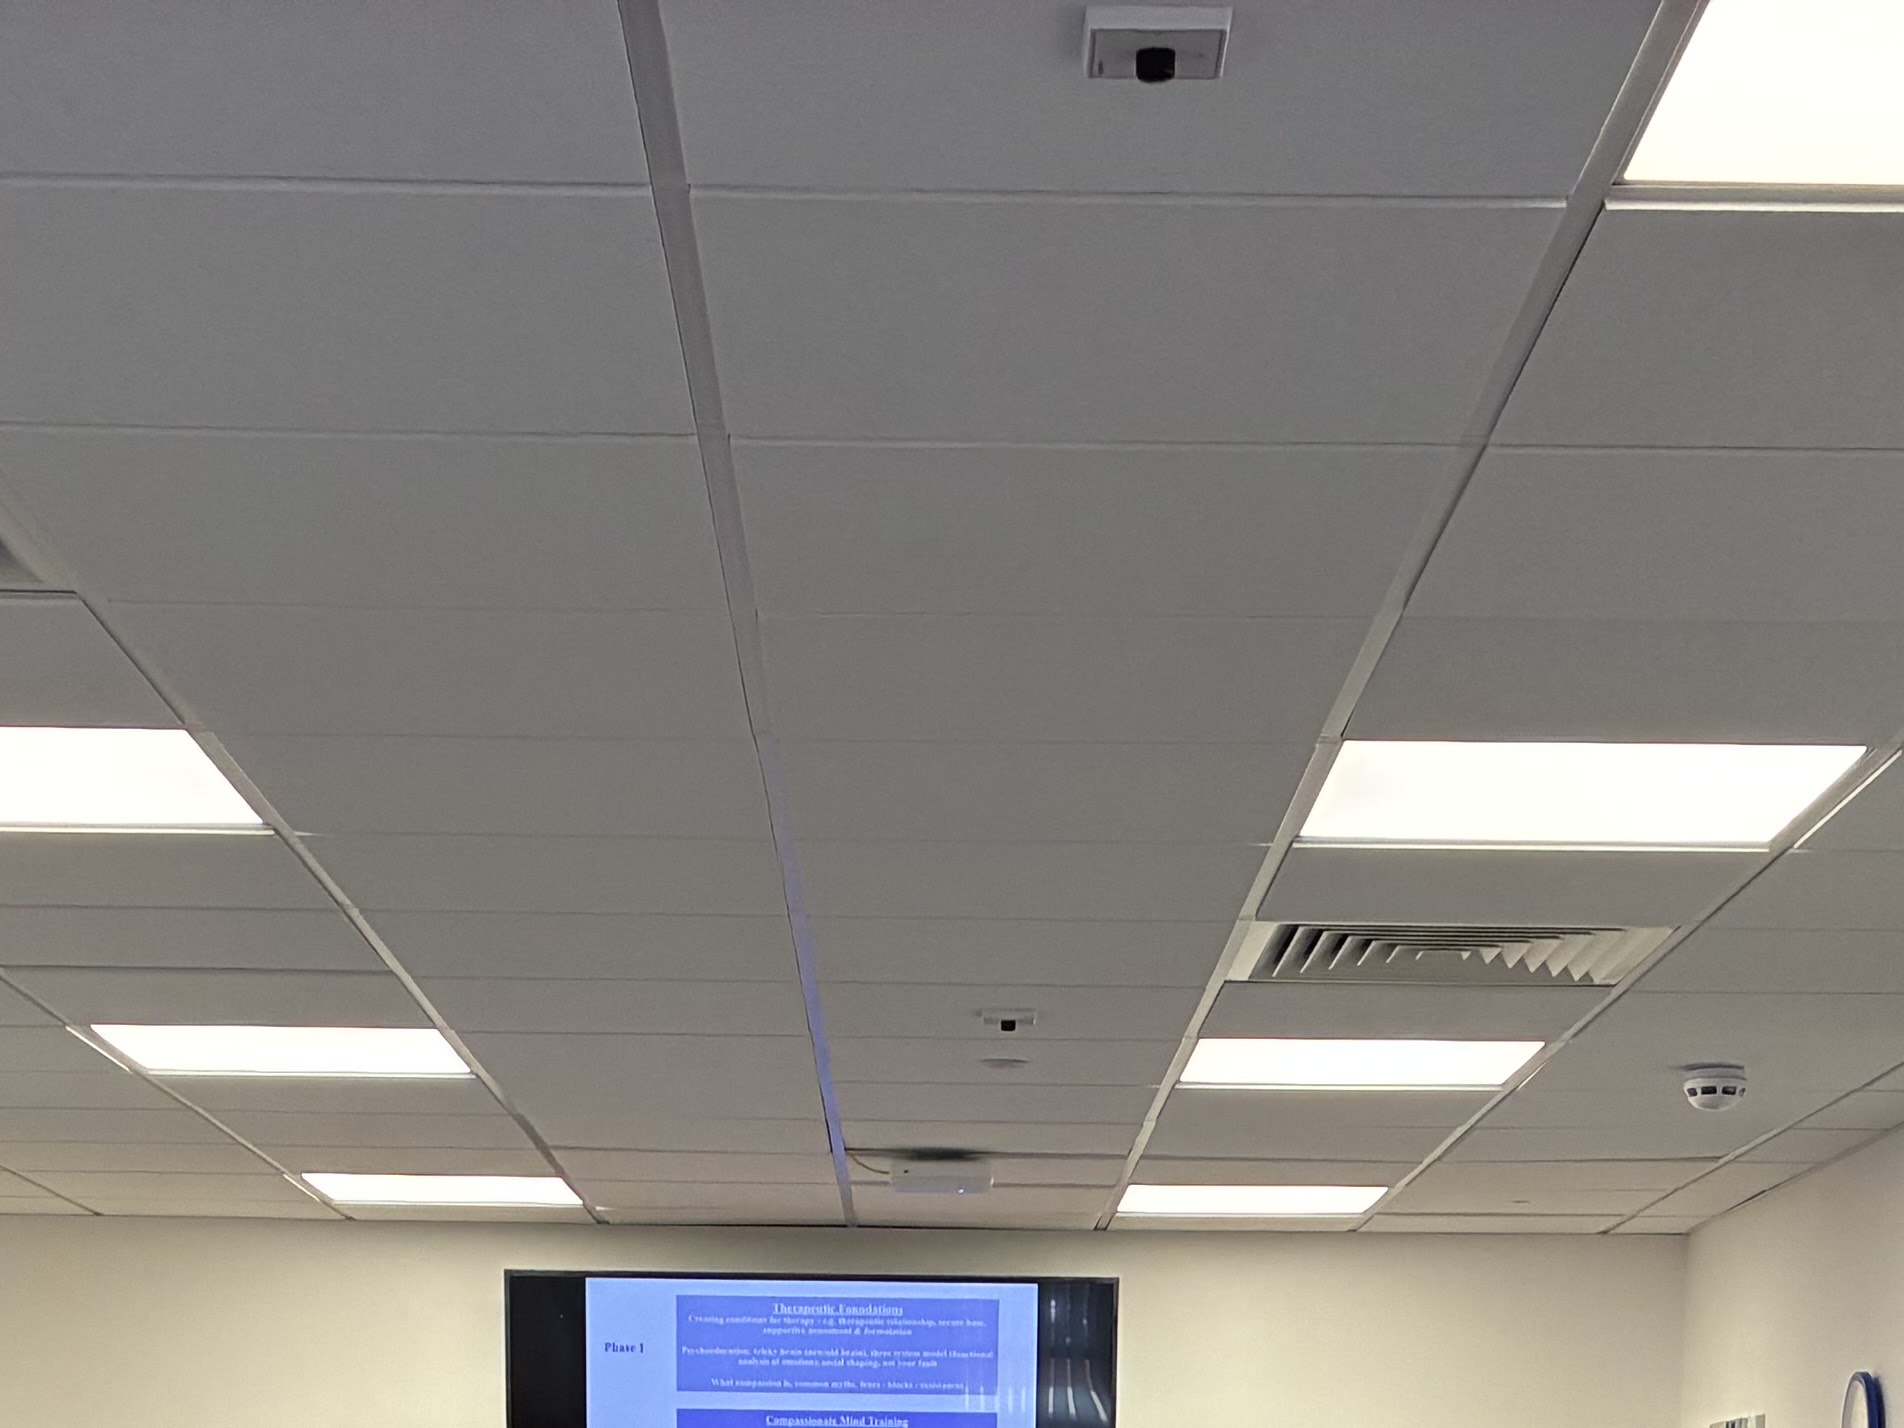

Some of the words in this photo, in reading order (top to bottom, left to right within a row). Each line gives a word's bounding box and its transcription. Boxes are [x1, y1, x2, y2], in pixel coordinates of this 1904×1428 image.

[773, 1303, 835, 1315] Therapeutic
[839, 1304, 904, 1316] Foundations
[604, 1342, 636, 1353] Phase
[639, 1342, 645, 1353] 1
[765, 1415, 836, 1427] Compassionate
[840, 1415, 866, 1427] Mind
[869, 1416, 908, 1428] Training
